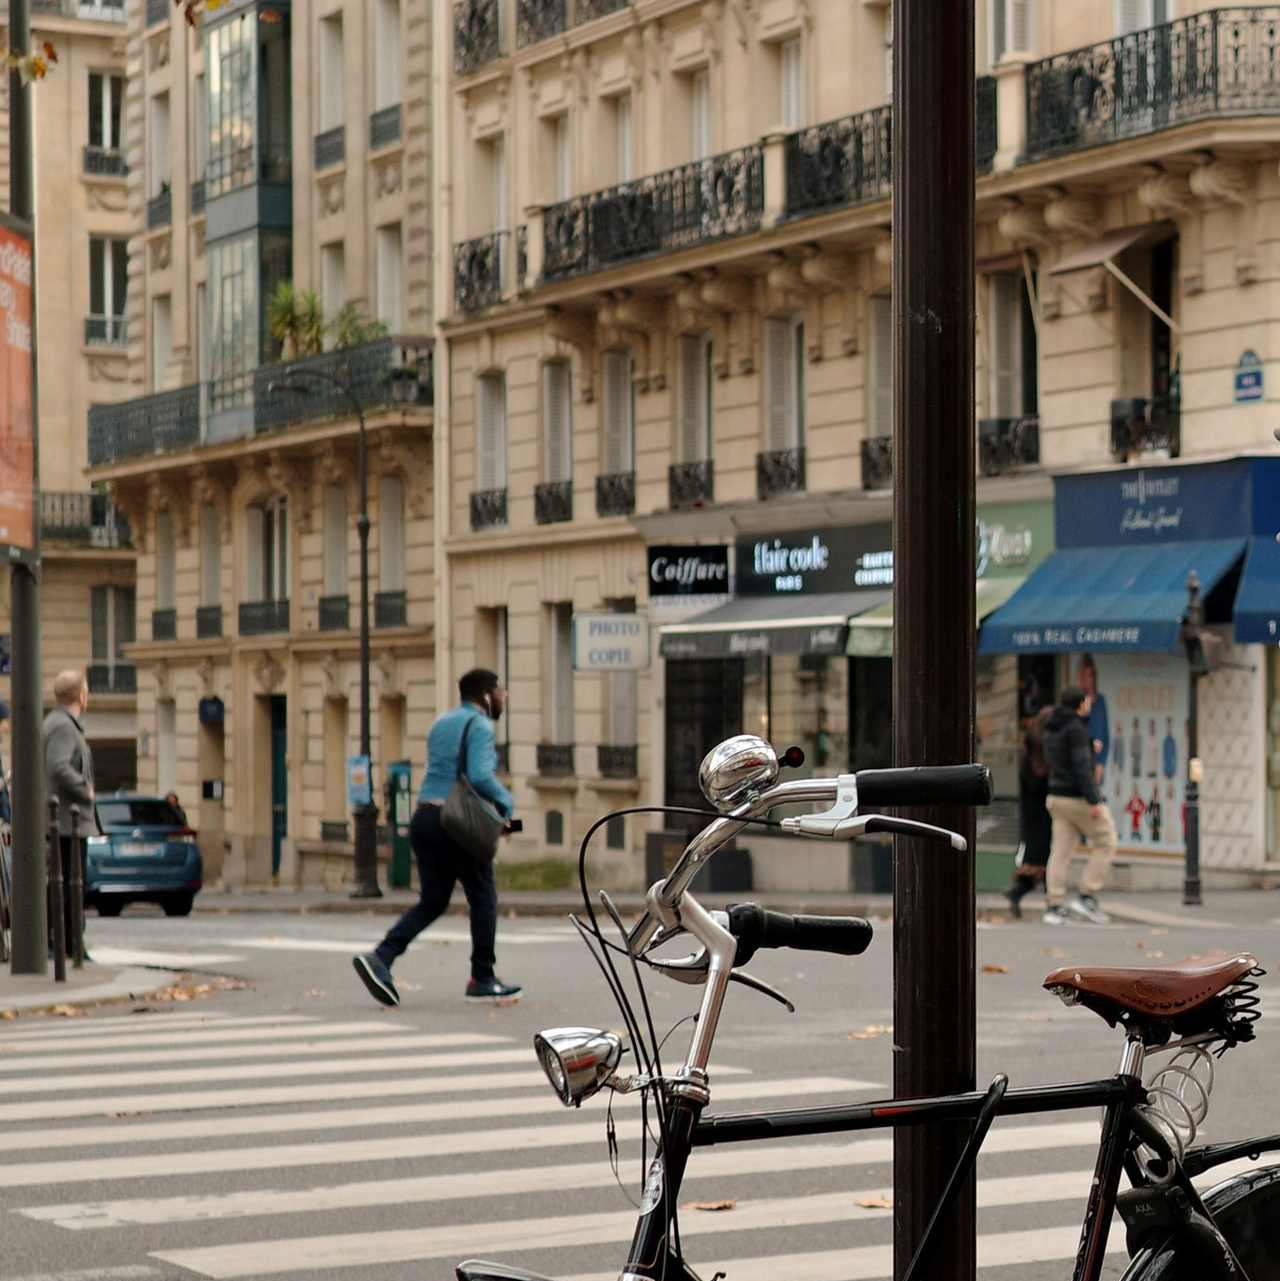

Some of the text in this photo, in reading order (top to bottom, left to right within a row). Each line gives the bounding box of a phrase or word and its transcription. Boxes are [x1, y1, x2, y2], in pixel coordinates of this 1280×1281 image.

[789, 535, 829, 572] code
[650, 557, 726, 584] Coiffure
[589, 622, 640, 637] PHOTO
[1044, 628, 1074, 644] REAL
[1076, 625, 1140, 644] CASHMERE
[588, 646, 632, 664] COPIE
[1135, 1203, 1154, 1214] AXA
